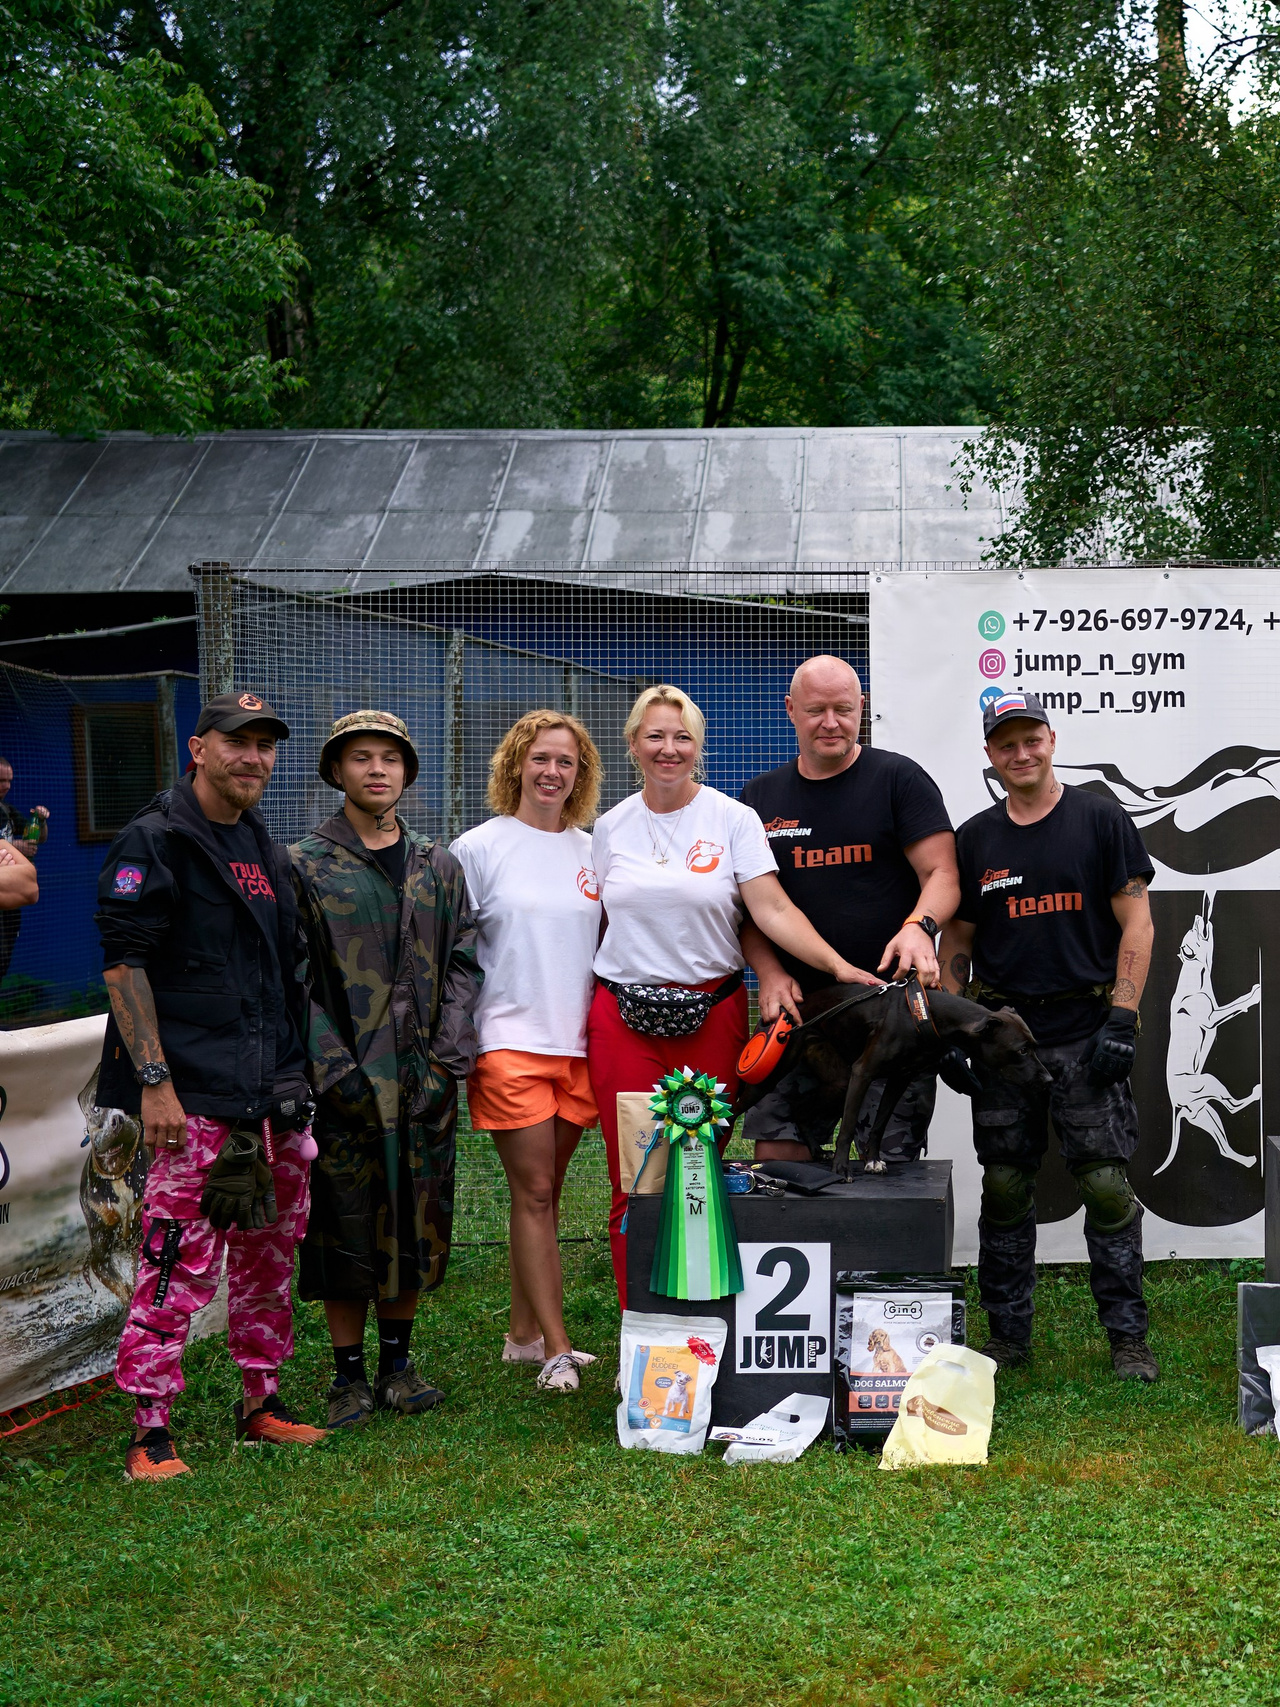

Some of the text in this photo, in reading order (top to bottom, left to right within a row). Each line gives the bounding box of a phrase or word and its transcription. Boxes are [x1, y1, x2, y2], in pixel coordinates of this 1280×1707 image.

[1013, 608, 1253, 635] +7-926-697-9724,
[1013, 649, 1185, 677] jump_n_gym
[1016, 687, 1185, 714] mp_n_gym
[791, 844, 873, 869] team
[1005, 892, 1083, 919] team
[692, 1173, 698, 1181] 2
[0, 1267, 39, 1291] ЛАССА
[755, 1246, 811, 1331] 2
[740, 1336, 827, 1369] JUMP
[854, 1380, 909, 1388] DOG SALMO
